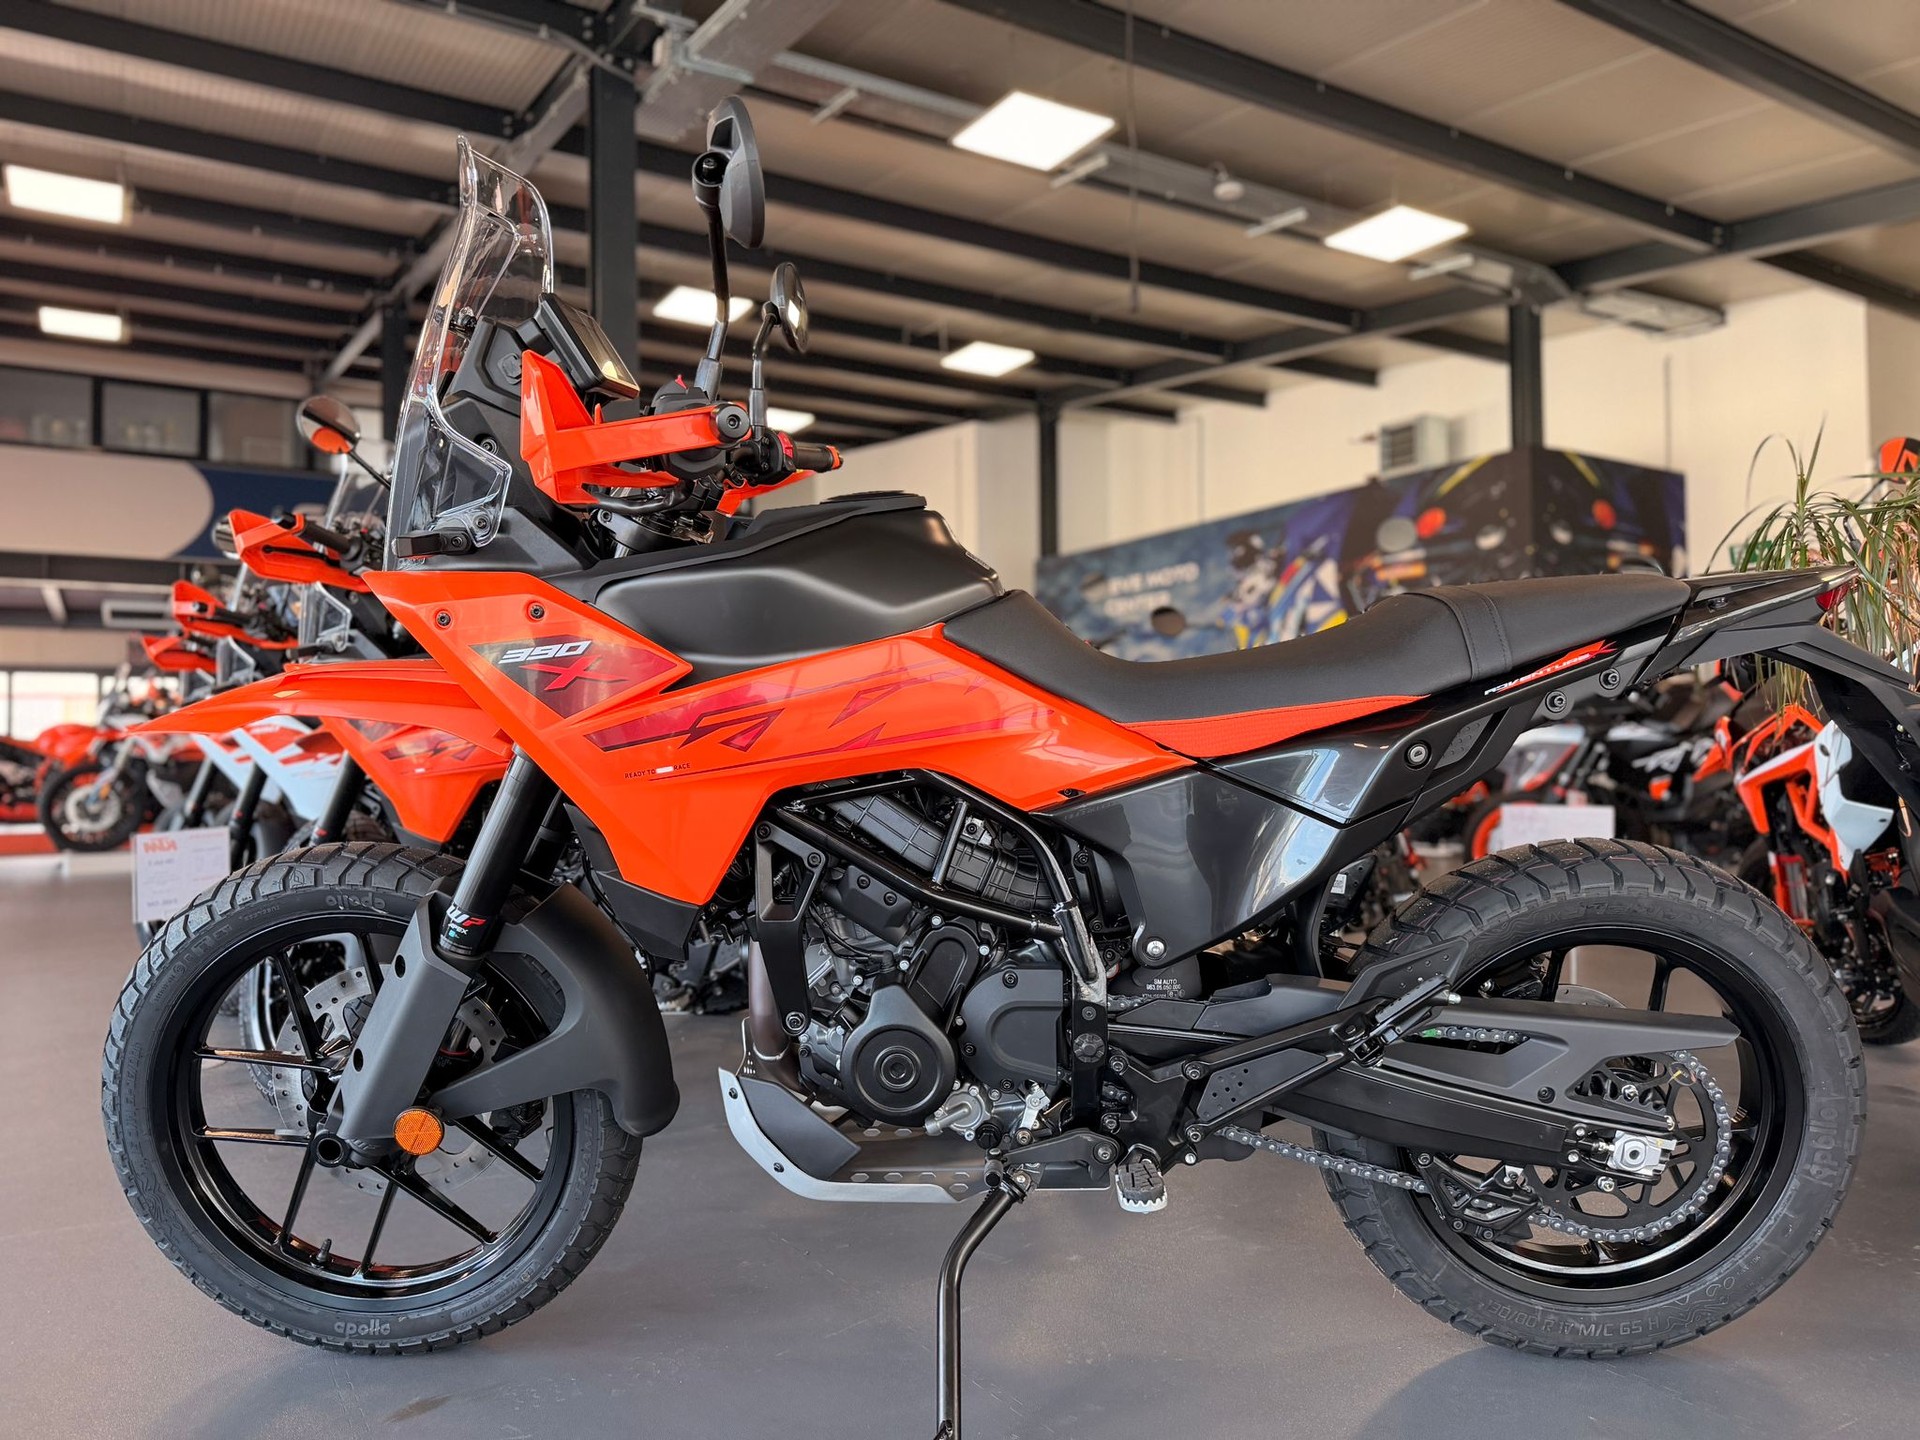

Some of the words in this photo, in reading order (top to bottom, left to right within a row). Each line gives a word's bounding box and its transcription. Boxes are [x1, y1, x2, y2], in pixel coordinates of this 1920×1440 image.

[498, 640, 592, 664] 390
[624, 770, 646, 779] READY
[673, 762, 691, 771] RACE
[325, 892, 386, 911] apollo
[333, 1319, 391, 1340] apollo
[1578, 1322, 1614, 1337] M/C
